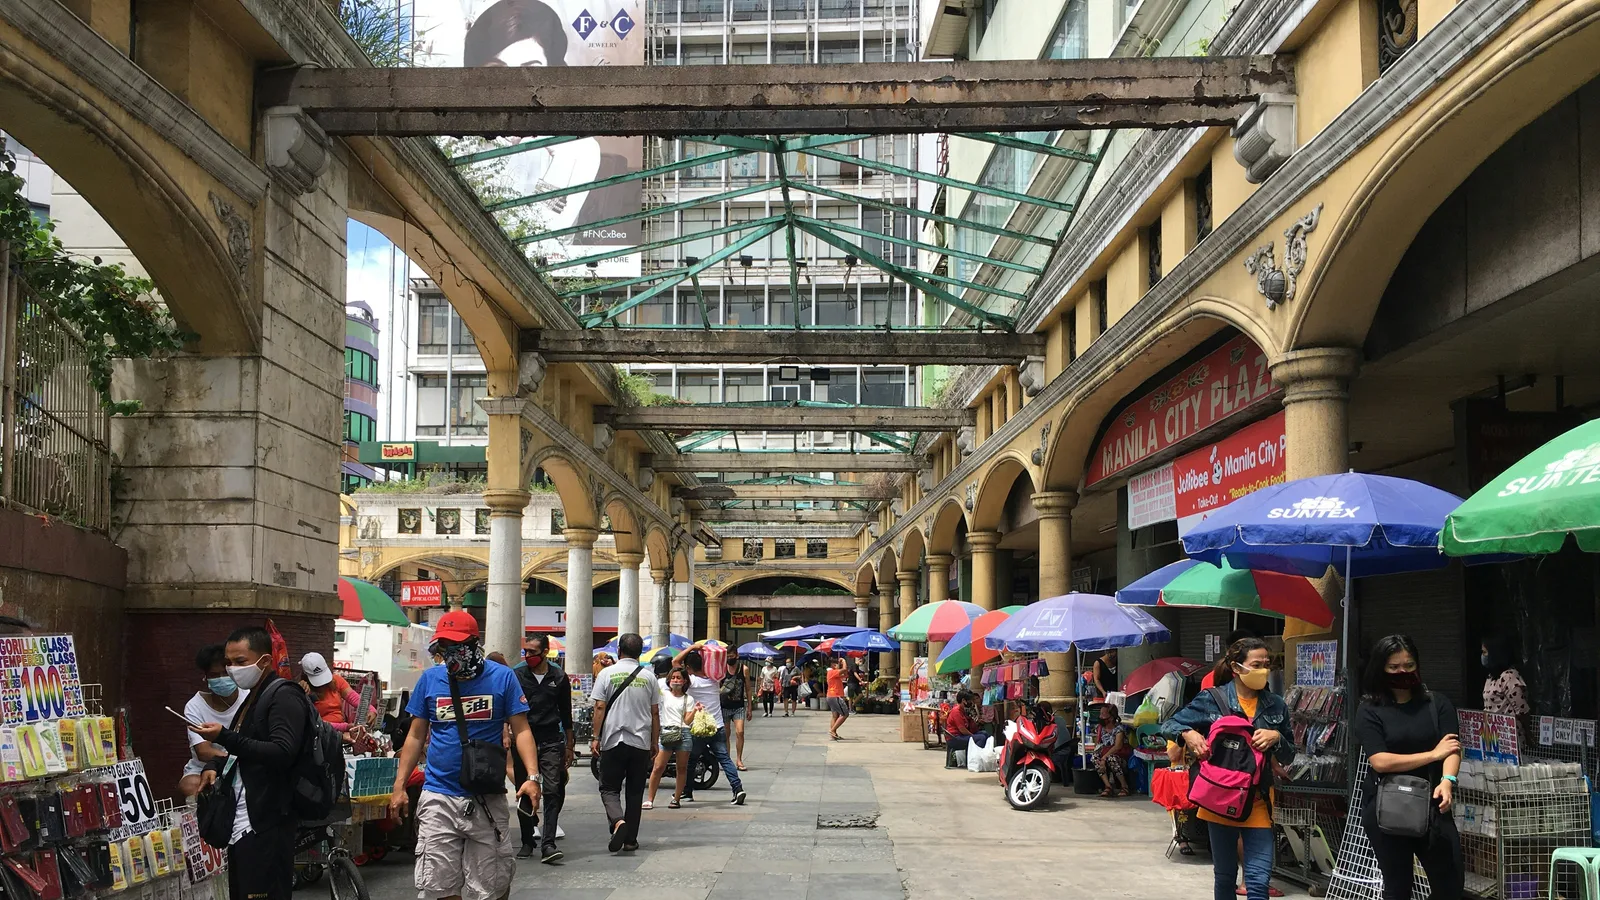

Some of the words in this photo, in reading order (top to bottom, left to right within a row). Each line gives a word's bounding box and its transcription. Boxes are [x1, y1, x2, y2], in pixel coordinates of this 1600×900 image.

[579, 16, 592, 33] F
[614, 16, 630, 34] C
[582, 229, 627, 239] #FNCxBea
[1101, 418, 1158, 476] MANILA
[1164, 390, 1204, 444] CITY
[1177, 468, 1209, 494] Jollibee
[1224, 446, 1256, 477] Manila
[1258, 440, 1277, 469] City
[1497, 464, 1600, 497] SUNTE
[1197, 495, 1218, 509] Take-Out
[1267, 506, 1360, 519] SUNTEX
[412, 586, 440, 595] VISION
[0, 638, 39, 656] GORILLA
[0, 654, 45, 668] TEMPERED
[47, 652, 76, 665] GLASS
[1312, 652, 1324, 679] 100
[0, 668, 20, 680] FULL
[62, 680, 80, 691] 250
[2, 689, 21, 701] 200
[21, 666, 65, 720] 100
[67, 705, 84, 717] 200
[4, 712, 24, 724] 150
[1555, 730, 1571, 741] ONLY
[117, 774, 156, 823] 50
[192, 853, 202, 864] 80
[200, 837, 222, 873] 50
[195, 868, 206, 880] 100
